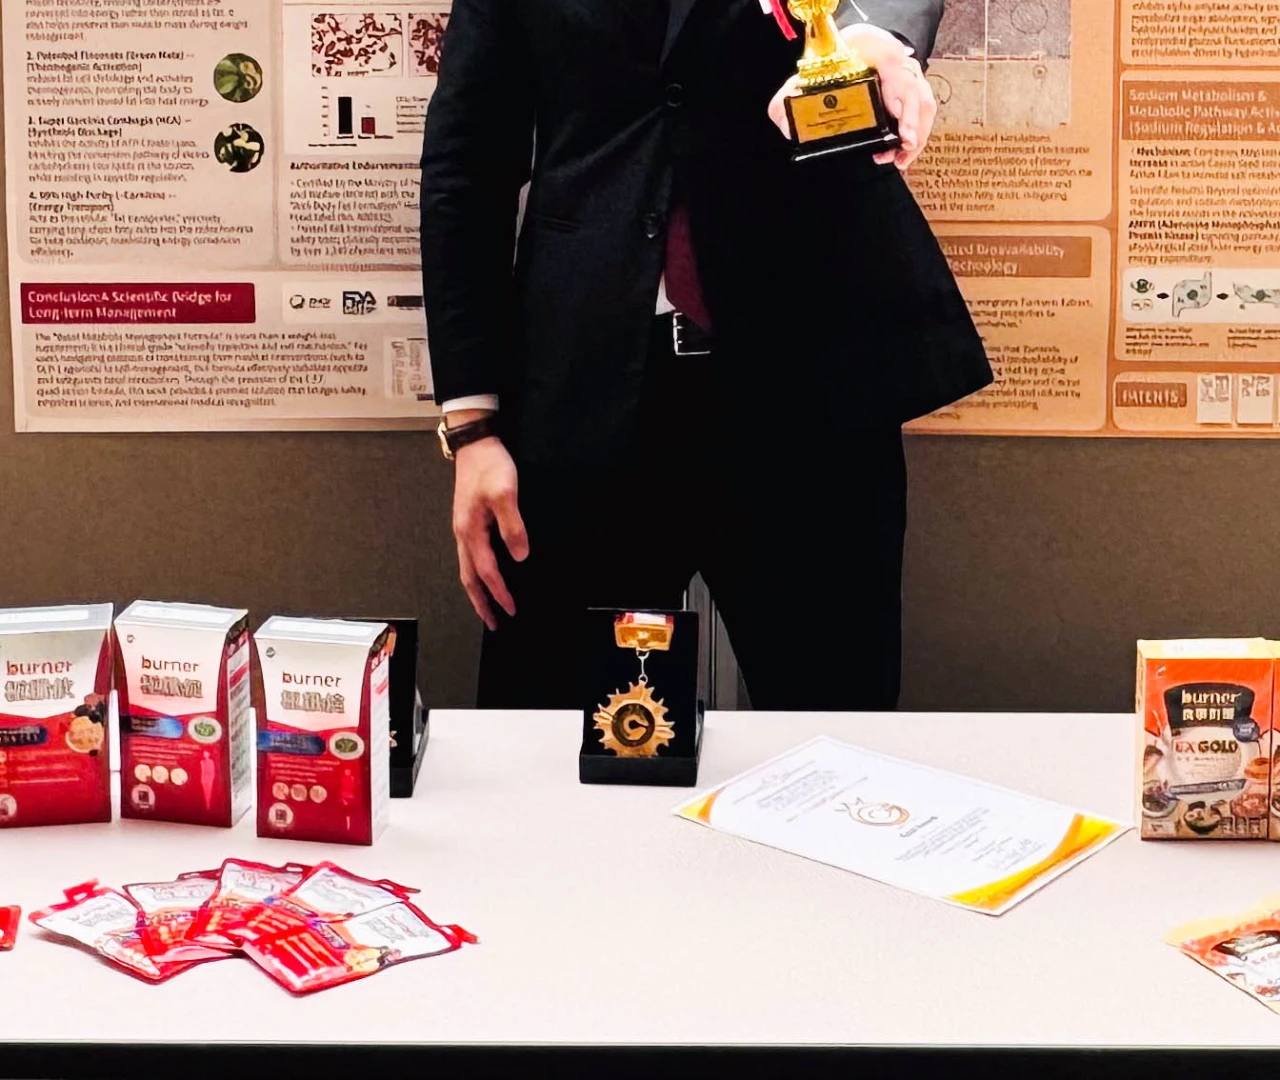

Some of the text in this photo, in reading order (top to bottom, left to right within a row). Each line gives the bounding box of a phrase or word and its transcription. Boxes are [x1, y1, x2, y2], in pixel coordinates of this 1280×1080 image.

[111, 290, 169, 304] Scientific
[214, 290, 233, 303] for
[6, 659, 74, 677] burner
[141, 655, 200, 673] burner
[281, 671, 343, 688] burner
[1181, 689, 1243, 705] burner
[1197, 739, 1239, 754] GOLD
